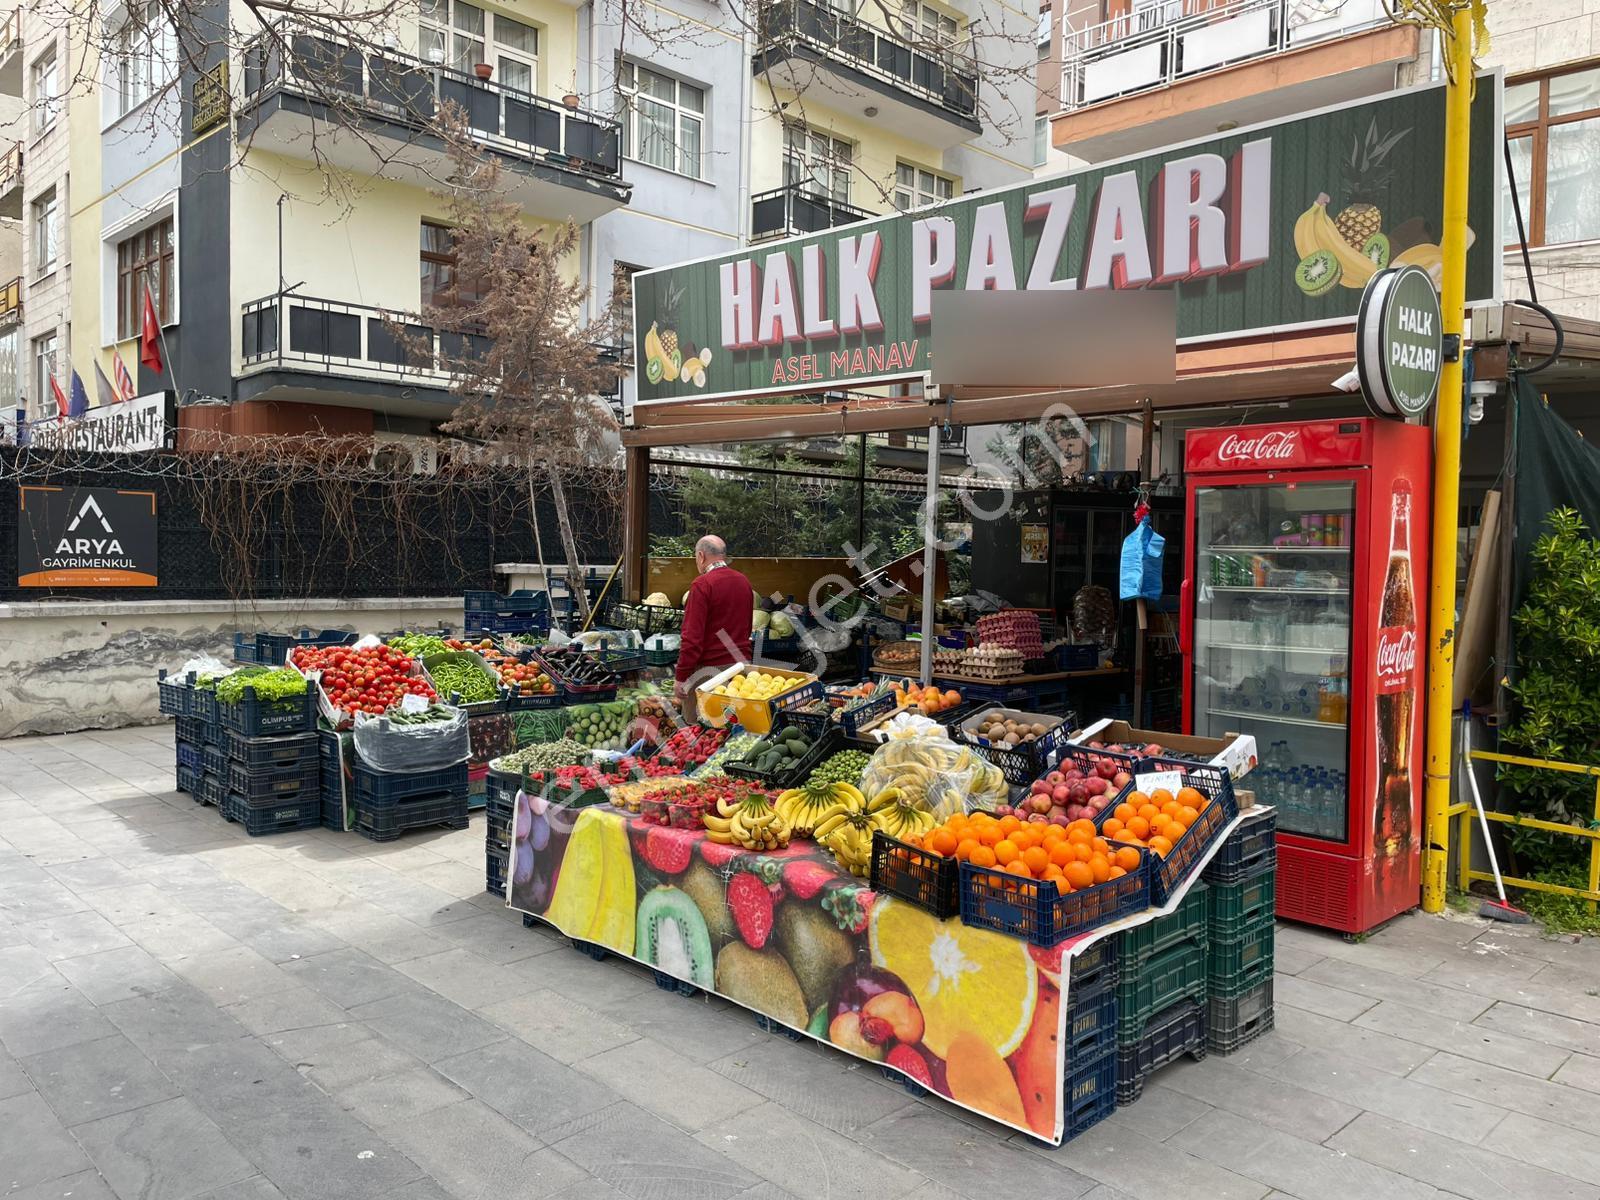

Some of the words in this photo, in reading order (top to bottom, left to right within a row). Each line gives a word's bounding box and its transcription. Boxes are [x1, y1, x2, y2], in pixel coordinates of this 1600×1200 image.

[720, 231, 884, 351] HALK
[912, 137, 1272, 323] PAZARI
[1398, 305, 1433, 337] HALK
[772, 354, 823, 384] ASEL
[829, 340, 919, 377] MANAV
[1391, 341, 1436, 373] PAZARI
[67, 405, 157, 451] RESTAURANT
[1218, 430, 1299, 462] Coca-Cola
[42, 556, 137, 568] GAYRİMENKUL
[55, 538, 124, 555] ARYA
[1376, 630, 1417, 677] Coca-Cola
